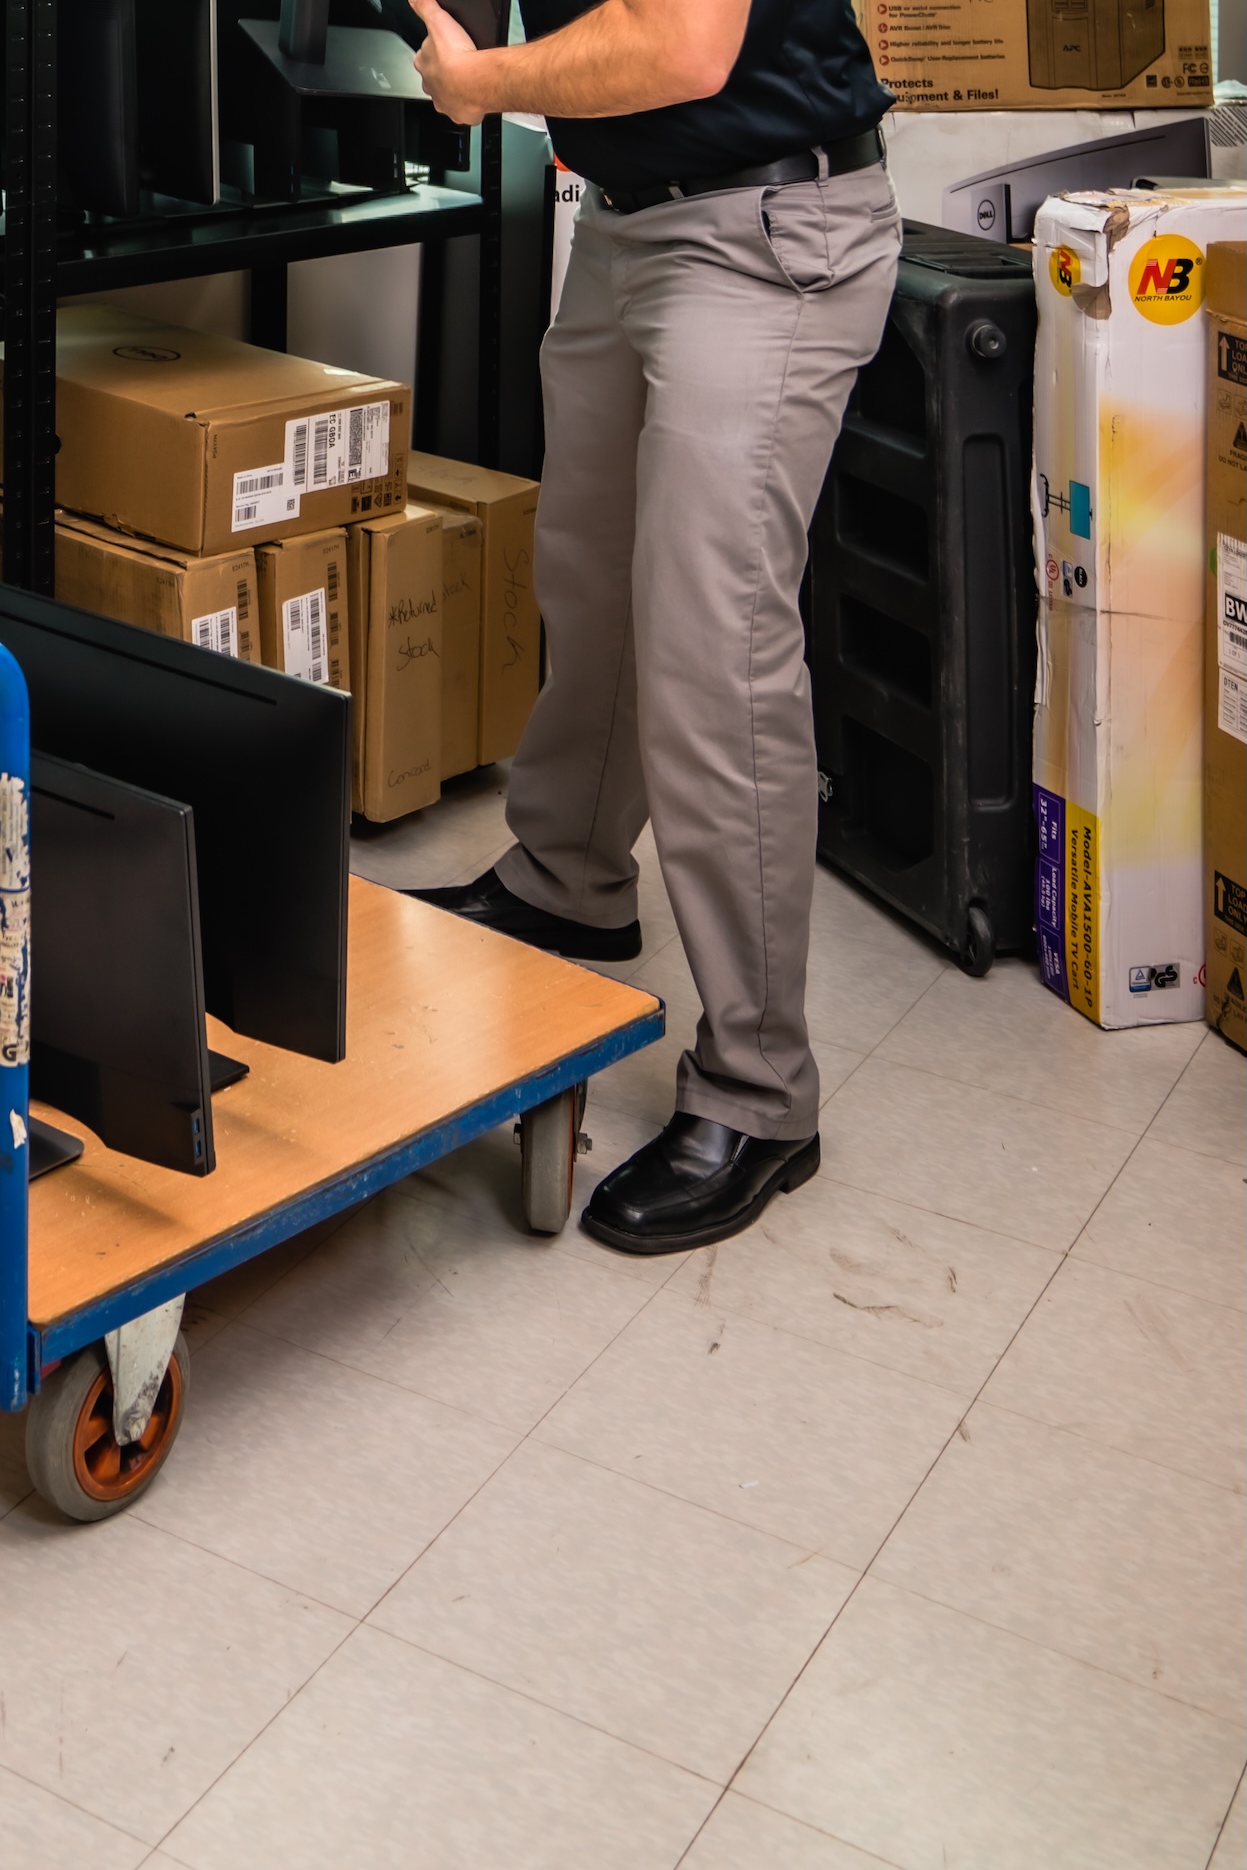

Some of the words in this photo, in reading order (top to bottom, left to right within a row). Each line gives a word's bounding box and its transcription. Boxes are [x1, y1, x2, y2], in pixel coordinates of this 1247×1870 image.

[953, 39, 971, 47] longer
[881, 79, 934, 89] Protects
[896, 91, 949, 104] uipment
[953, 90, 963, 101] &
[967, 88, 999, 101] Files!
[555, 184, 580, 203] adi
[979, 210, 994, 220] DELL
[1058, 249, 1073, 288] NB
[1136, 258, 1194, 295] NB
[1164, 294, 1192, 302] BAYOU
[1232, 350, 1247, 363] LOA
[1225, 596, 1247, 624] BW
[1050, 820, 1058, 840] Fits
[1070, 828, 1079, 890] Versatile
[1050, 867, 1058, 890] Load
[1050, 891, 1058, 928] Capacity
[1069, 892, 1079, 938] Mobile
[1071, 941, 1078, 959] TV
[1053, 951, 1061, 975] VESA
[1071, 961, 1080, 989] Cart
